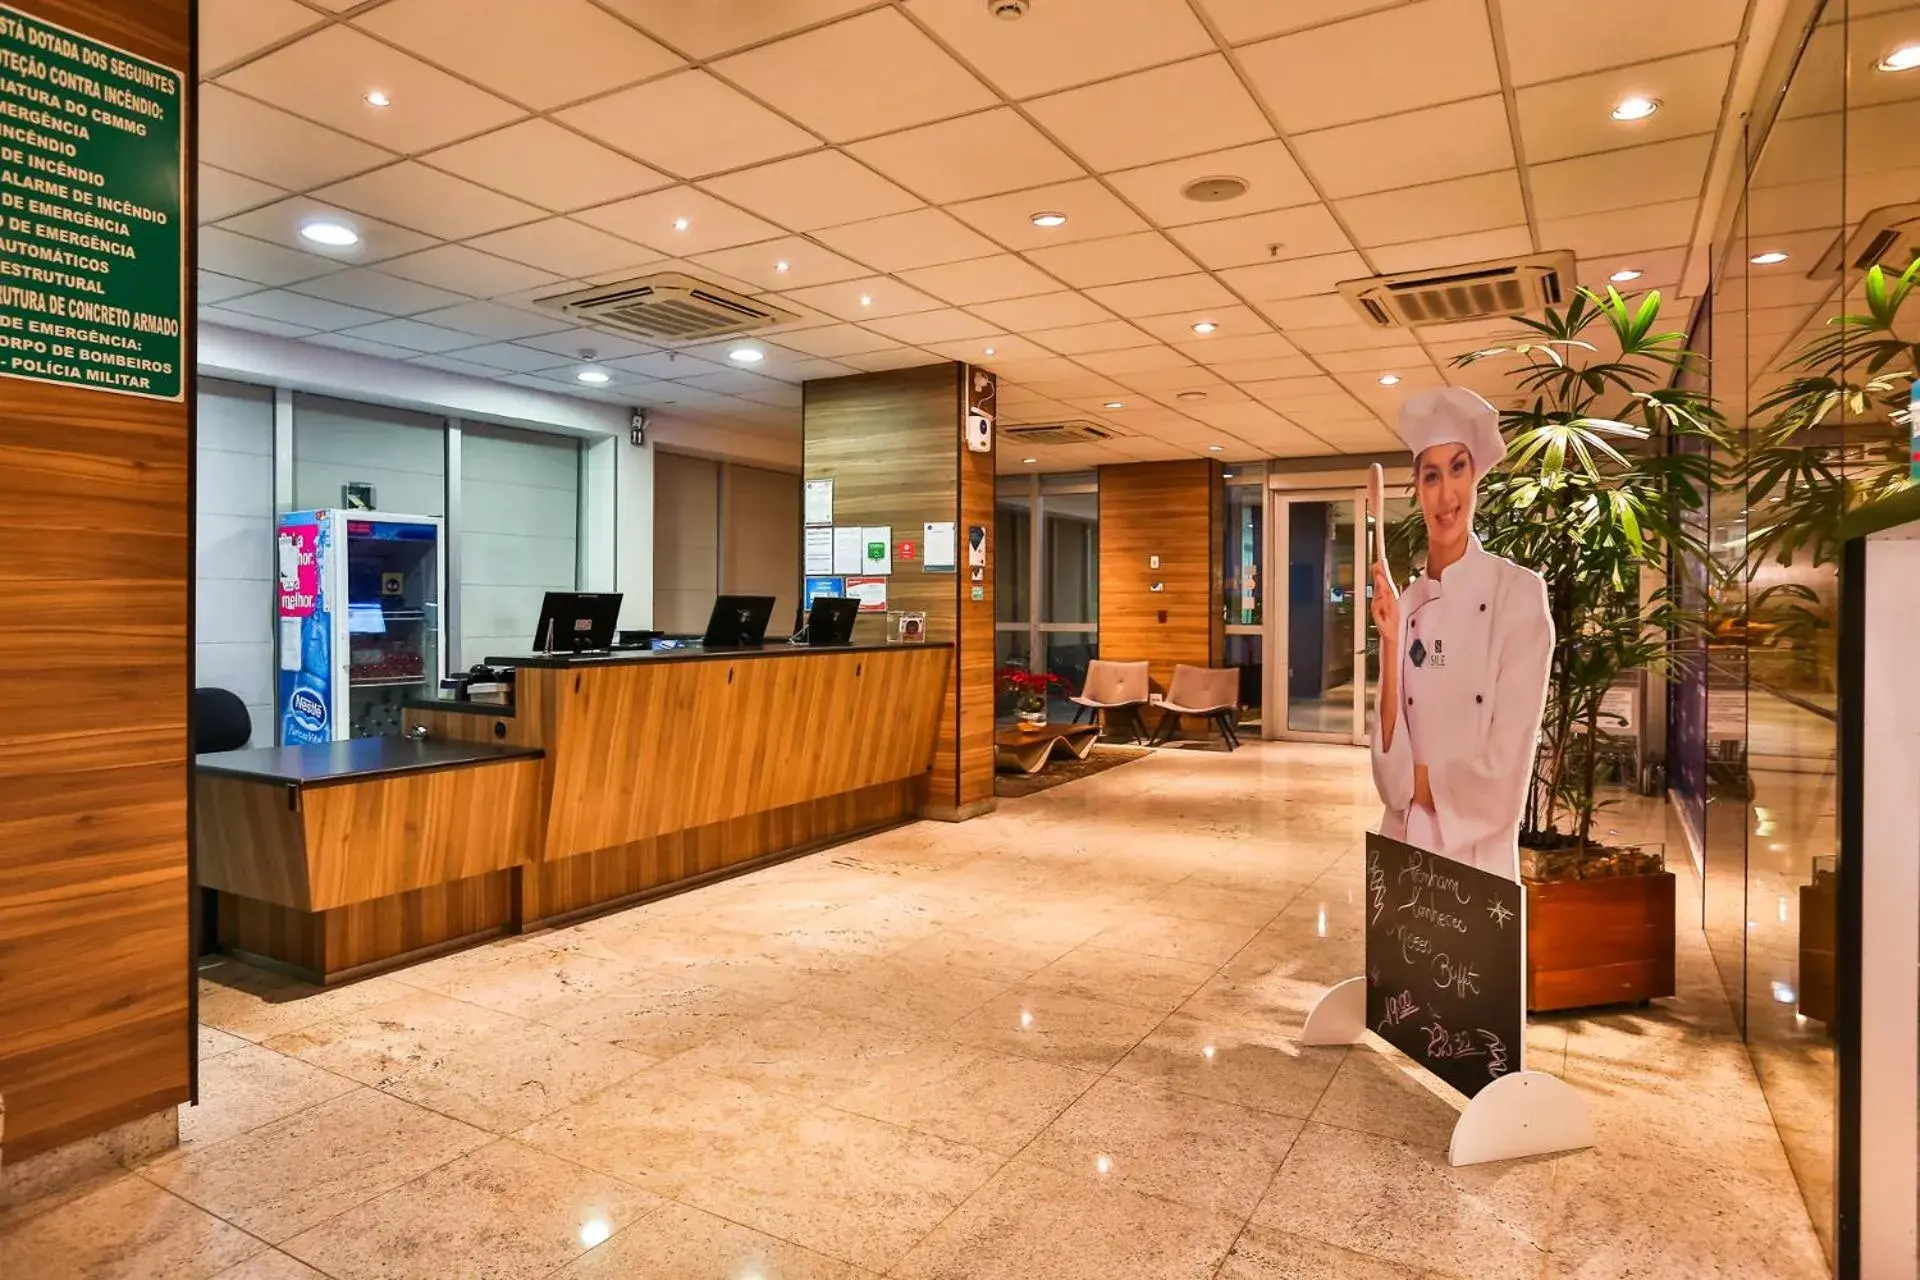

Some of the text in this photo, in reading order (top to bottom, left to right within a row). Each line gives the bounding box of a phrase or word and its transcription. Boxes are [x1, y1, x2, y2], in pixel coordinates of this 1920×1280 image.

[28, 27, 80, 61] DOTADA
[83, 47, 108, 71] DOS
[111, 58, 175, 95] SEGUINTES
[50, 66, 101, 99] CONTRA
[104, 84, 164, 120] INCÊNDIO:
[65, 100, 87, 117] DO
[91, 108, 147, 137] CBMMG
[1, 147, 105, 187] DE INCÊNDIO
[1, 170, 167, 225] ALARME DE INCÊNDIO
[2, 193, 24, 210] DE
[29, 199, 130, 236] EMERGÊNCIA
[9, 217, 31, 234] DE
[36, 224, 136, 259] EMERGÊNCIA
[1, 261, 105, 295] ESTRUTURAL
[0, 315, 142, 351] DE EMERGÊNCIA:
[50, 294, 65, 316] DE
[69, 299, 130, 328] CONCRETO
[133, 312, 178, 337] ARMADO
[12, 357, 81, 379] POLÍCIA
[86, 369, 151, 389] MILITAR
[52, 344, 74, 358] DE
[79, 348, 172, 374] BOMBEIROS
